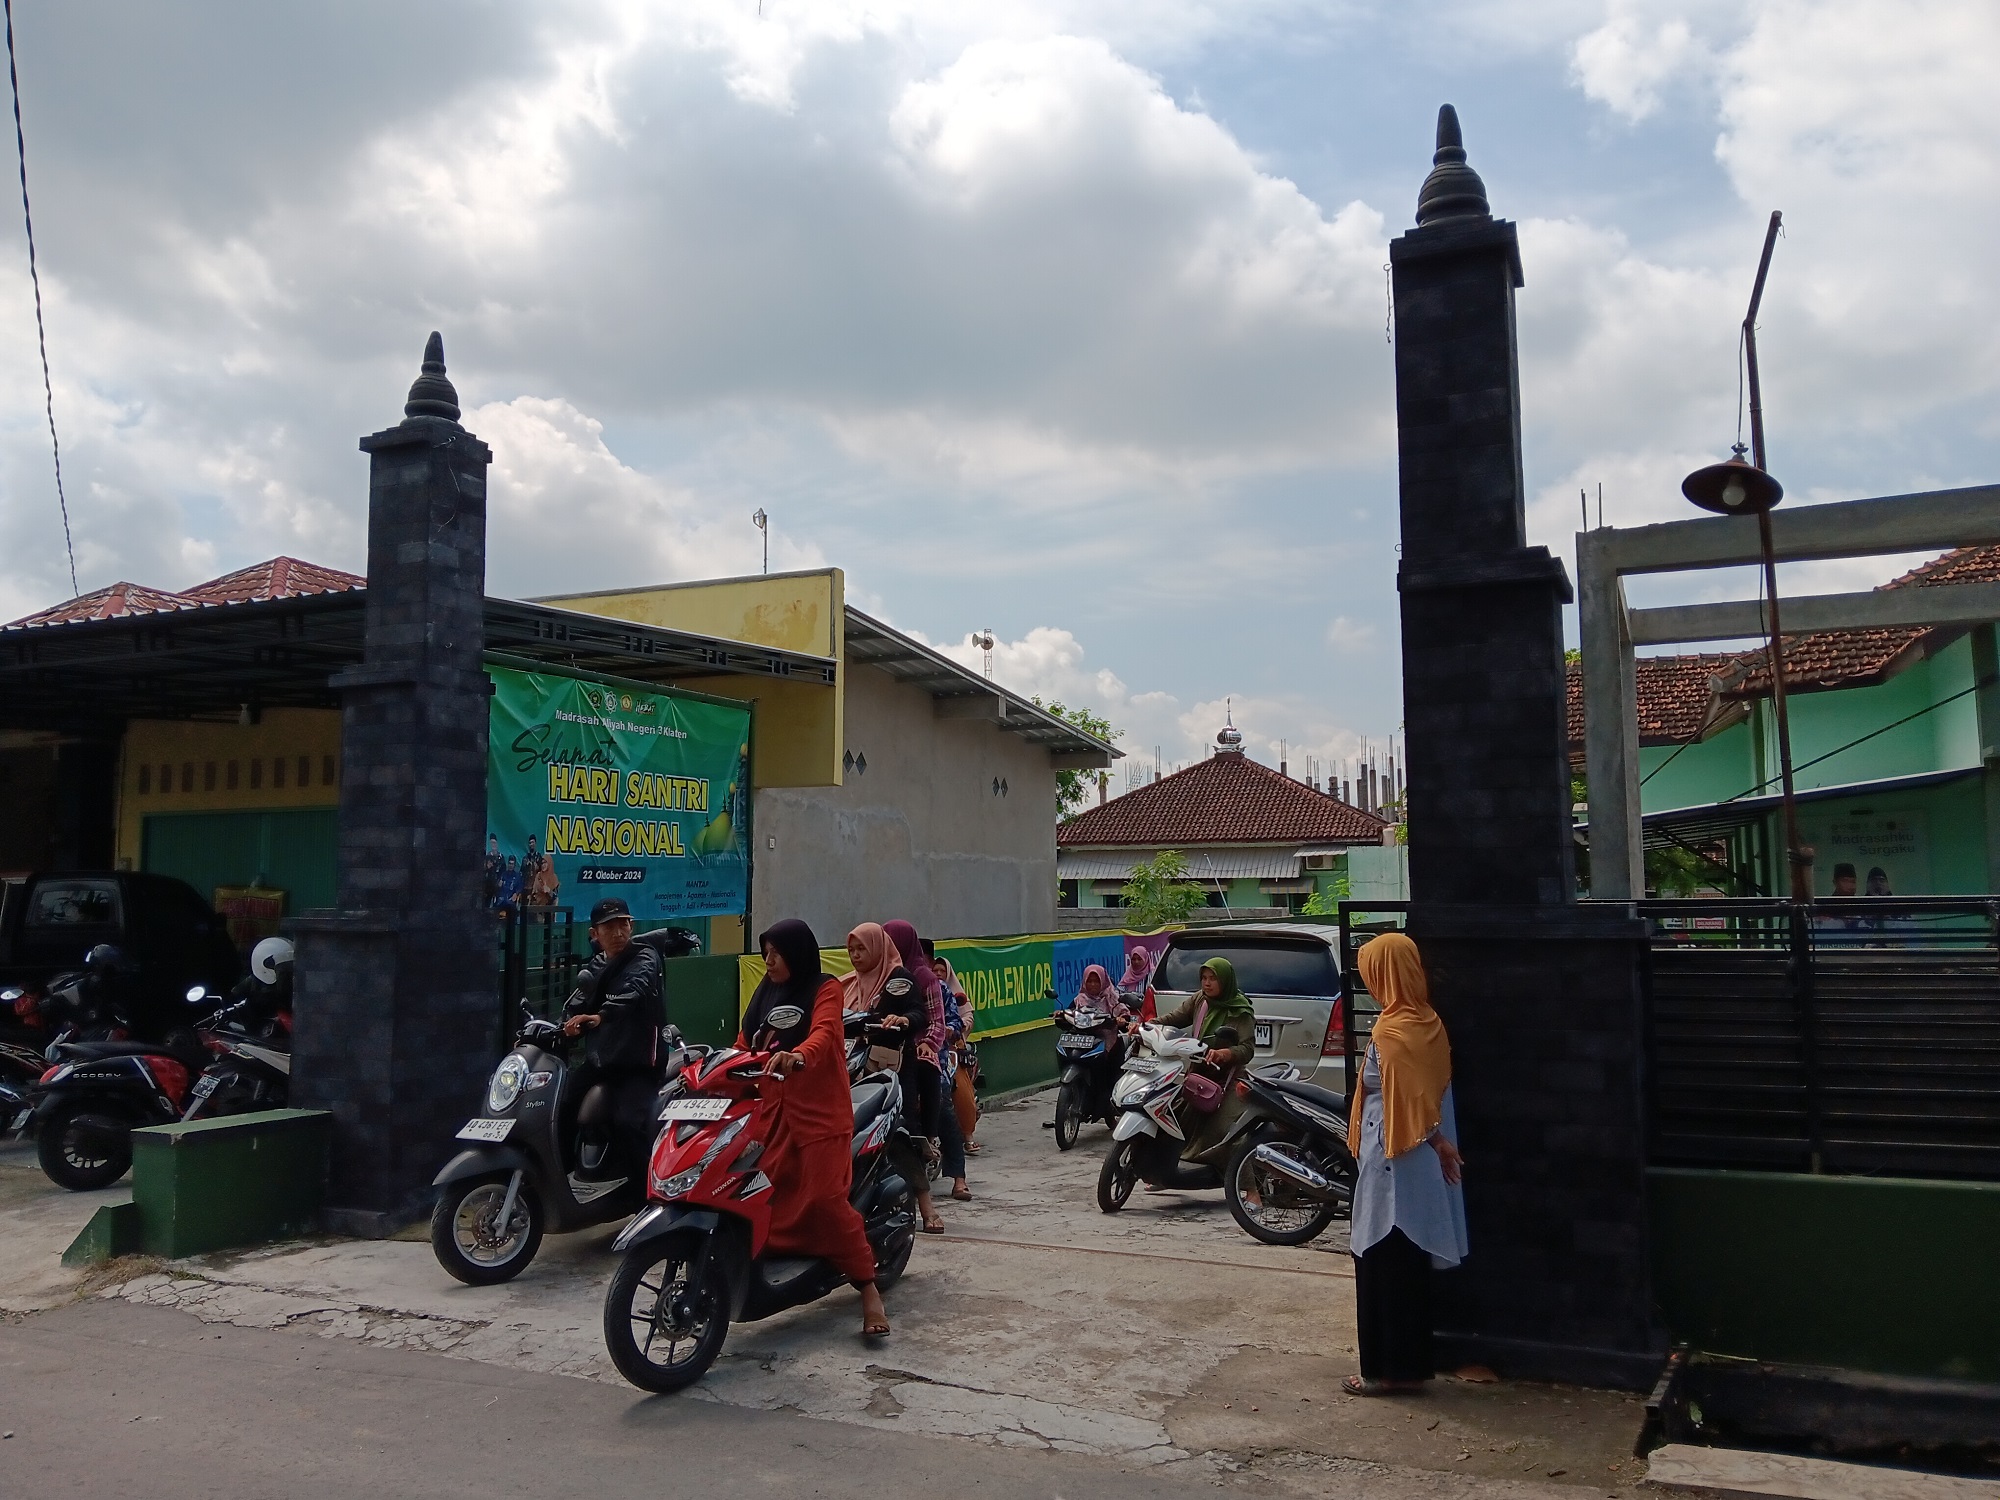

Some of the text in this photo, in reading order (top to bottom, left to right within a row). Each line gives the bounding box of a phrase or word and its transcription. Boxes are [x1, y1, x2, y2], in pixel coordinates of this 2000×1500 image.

[555, 710, 599, 726] Madrasah
[602, 717, 625, 732] Aliyah
[627, 721, 656, 736] Negeri
[663, 726, 687, 739] Klaten
[511, 723, 617, 772] Selamat
[549, 763, 708, 812] HARI SANTRI
[545, 815, 685, 857] NASIONAL
[1831, 831, 1914, 845] Madrasahku
[1859, 844, 1915, 857] Surgaku
[582, 870, 642, 880] 22 Oktober 2024
[525, 1100, 546, 1109] Stylish
[666, 1099, 729, 1109] AD 4942 DJ
[466, 1120, 479, 1129] AD
[711, 1176, 737, 1196] HONDA
